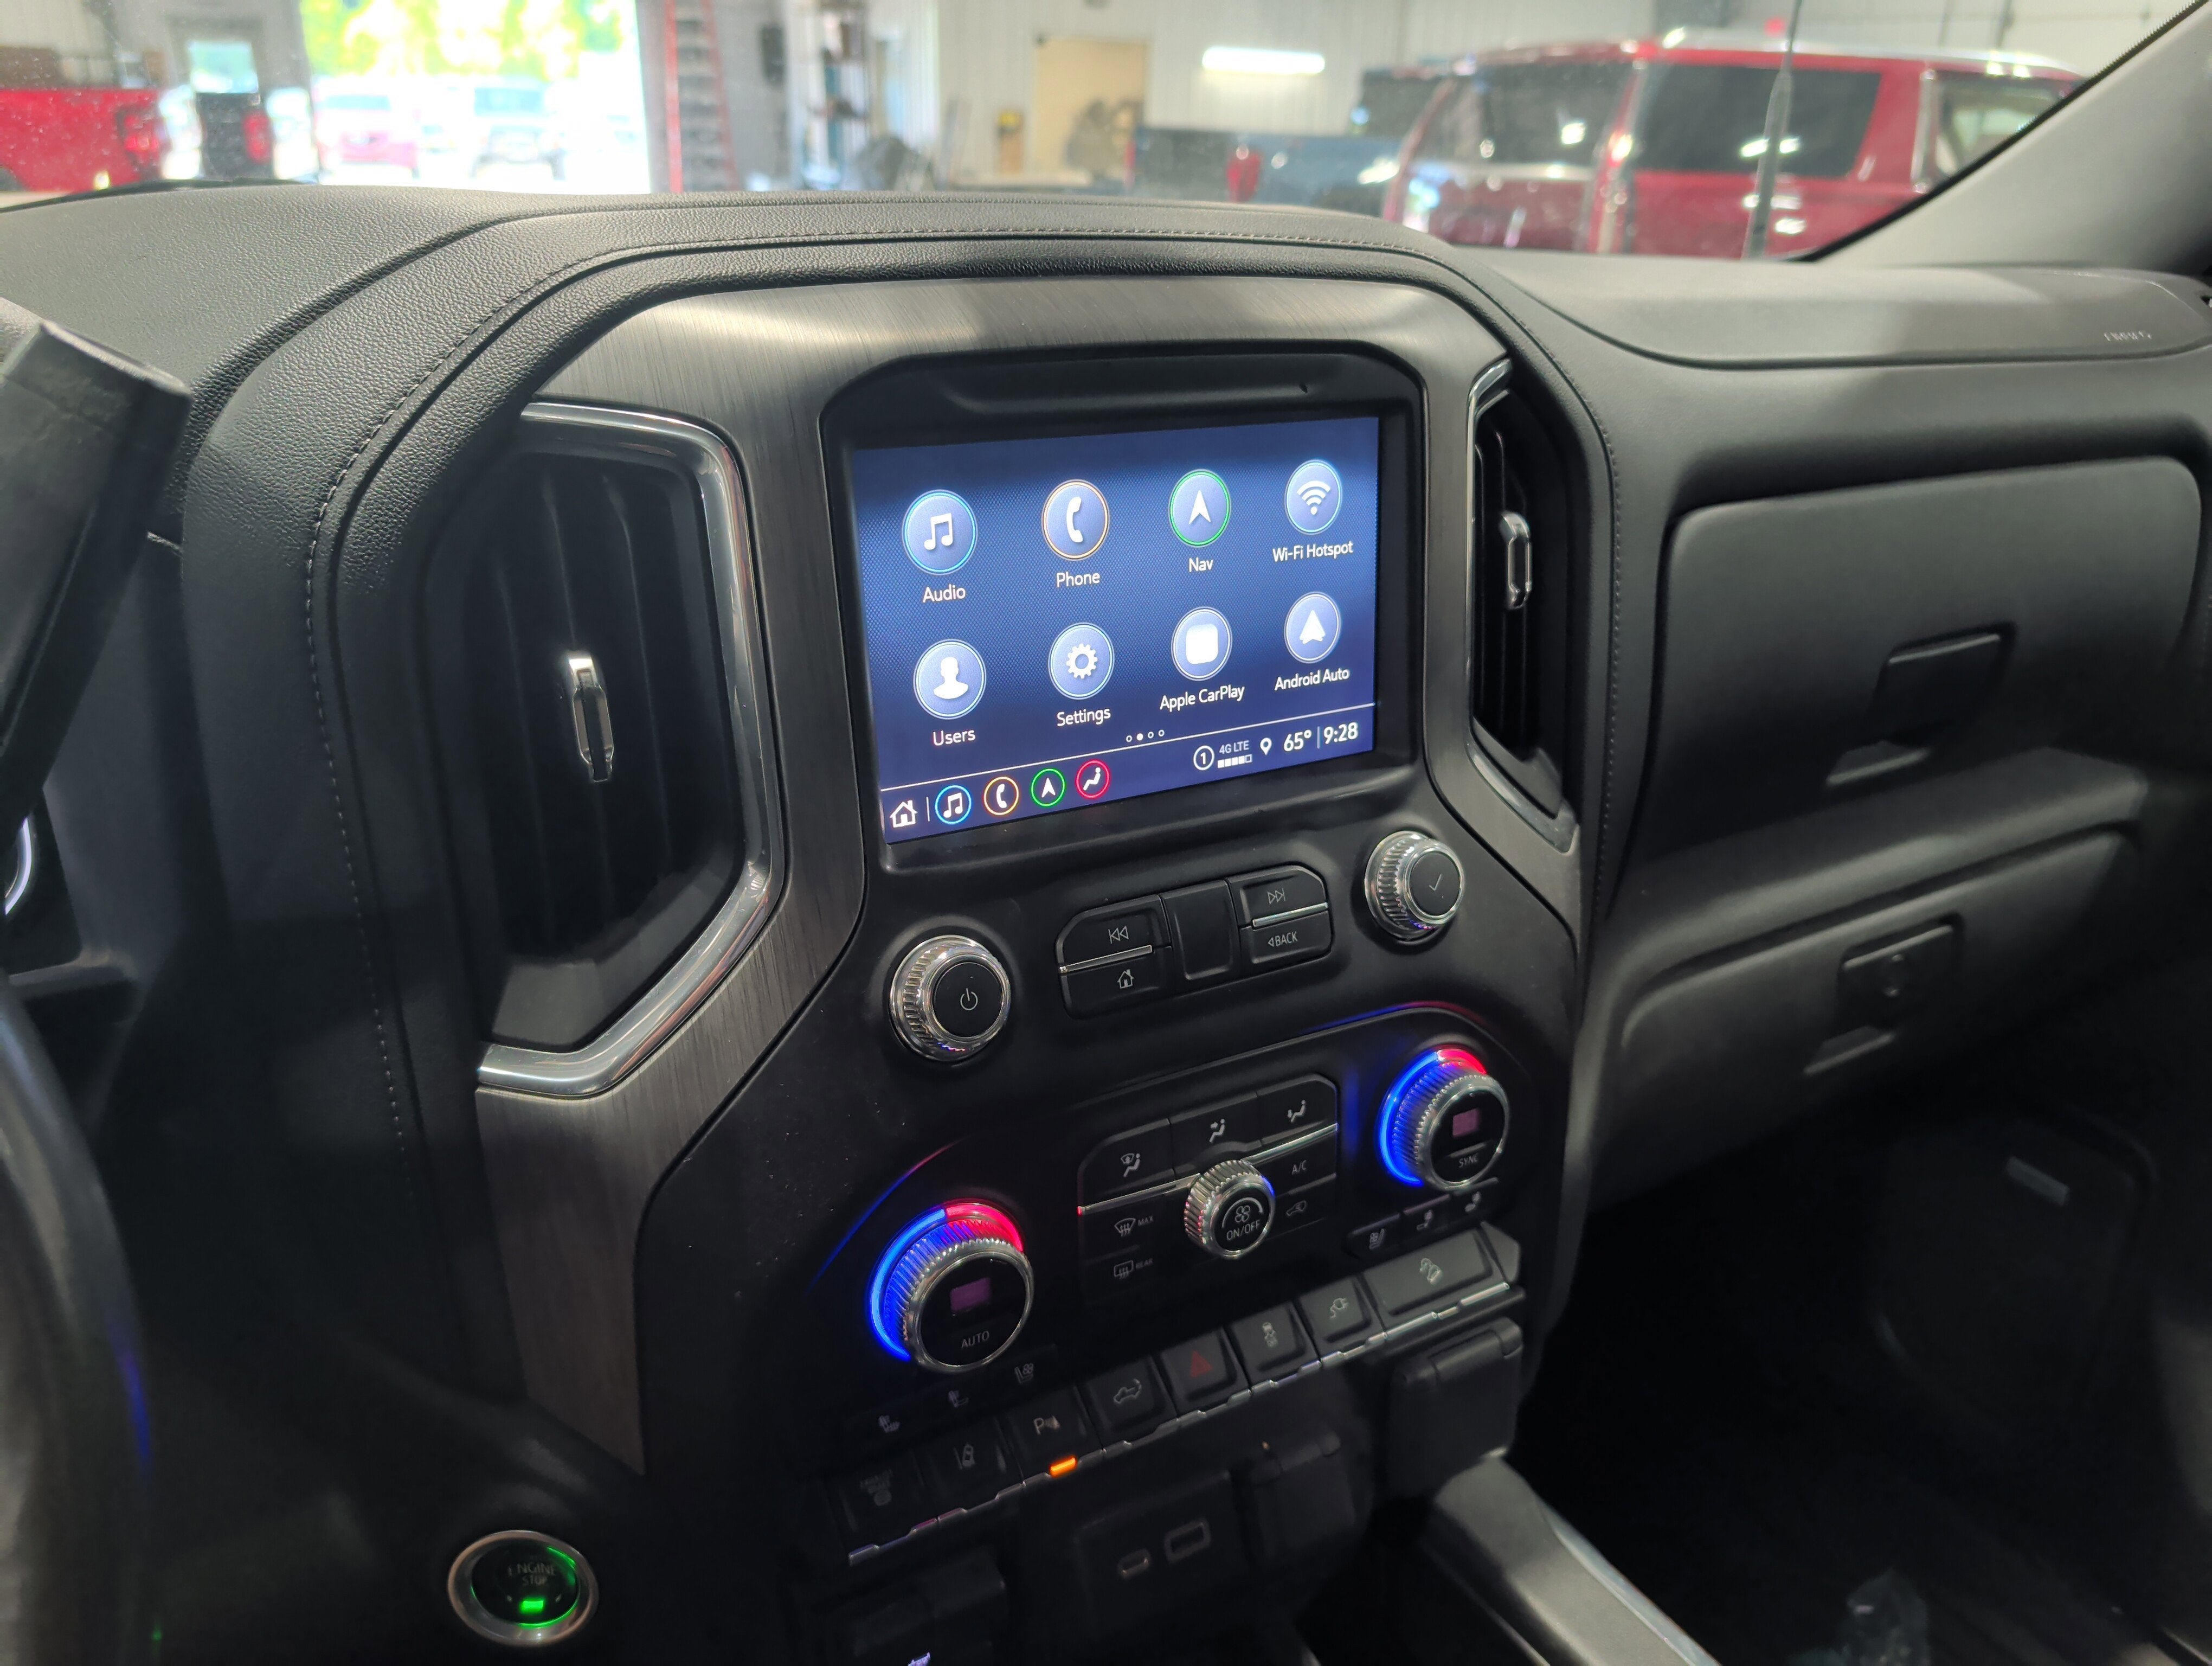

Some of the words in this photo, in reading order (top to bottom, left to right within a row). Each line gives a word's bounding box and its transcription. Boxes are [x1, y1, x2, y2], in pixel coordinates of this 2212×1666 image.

[1272, 545, 1303, 562] Wi-Fi
[1307, 541, 1353, 559] Hotspot
[1188, 557, 1213, 573] Nav
[1056, 571, 1100, 587] Phone
[923, 584, 966, 603] Audio
[1274, 670, 1321, 690] Android
[1322, 668, 1349, 683] Auto
[1160, 691, 1195, 712] Apple
[1199, 684, 1245, 701] CarPlay
[1057, 709, 1111, 727] Settings
[933, 730, 976, 746] Users
[1323, 722, 1358, 744] 9:28
[1219, 744, 1231, 754] 4G
[1233, 740, 1249, 752] LTE
[1275, 931, 1298, 946] BACK
[1291, 1160, 1307, 1175] A/C
[1458, 1154, 1479, 1168] SYNC
[1226, 1220, 1260, 1240] ON/OFF
[961, 1330, 989, 1349] AUTO
